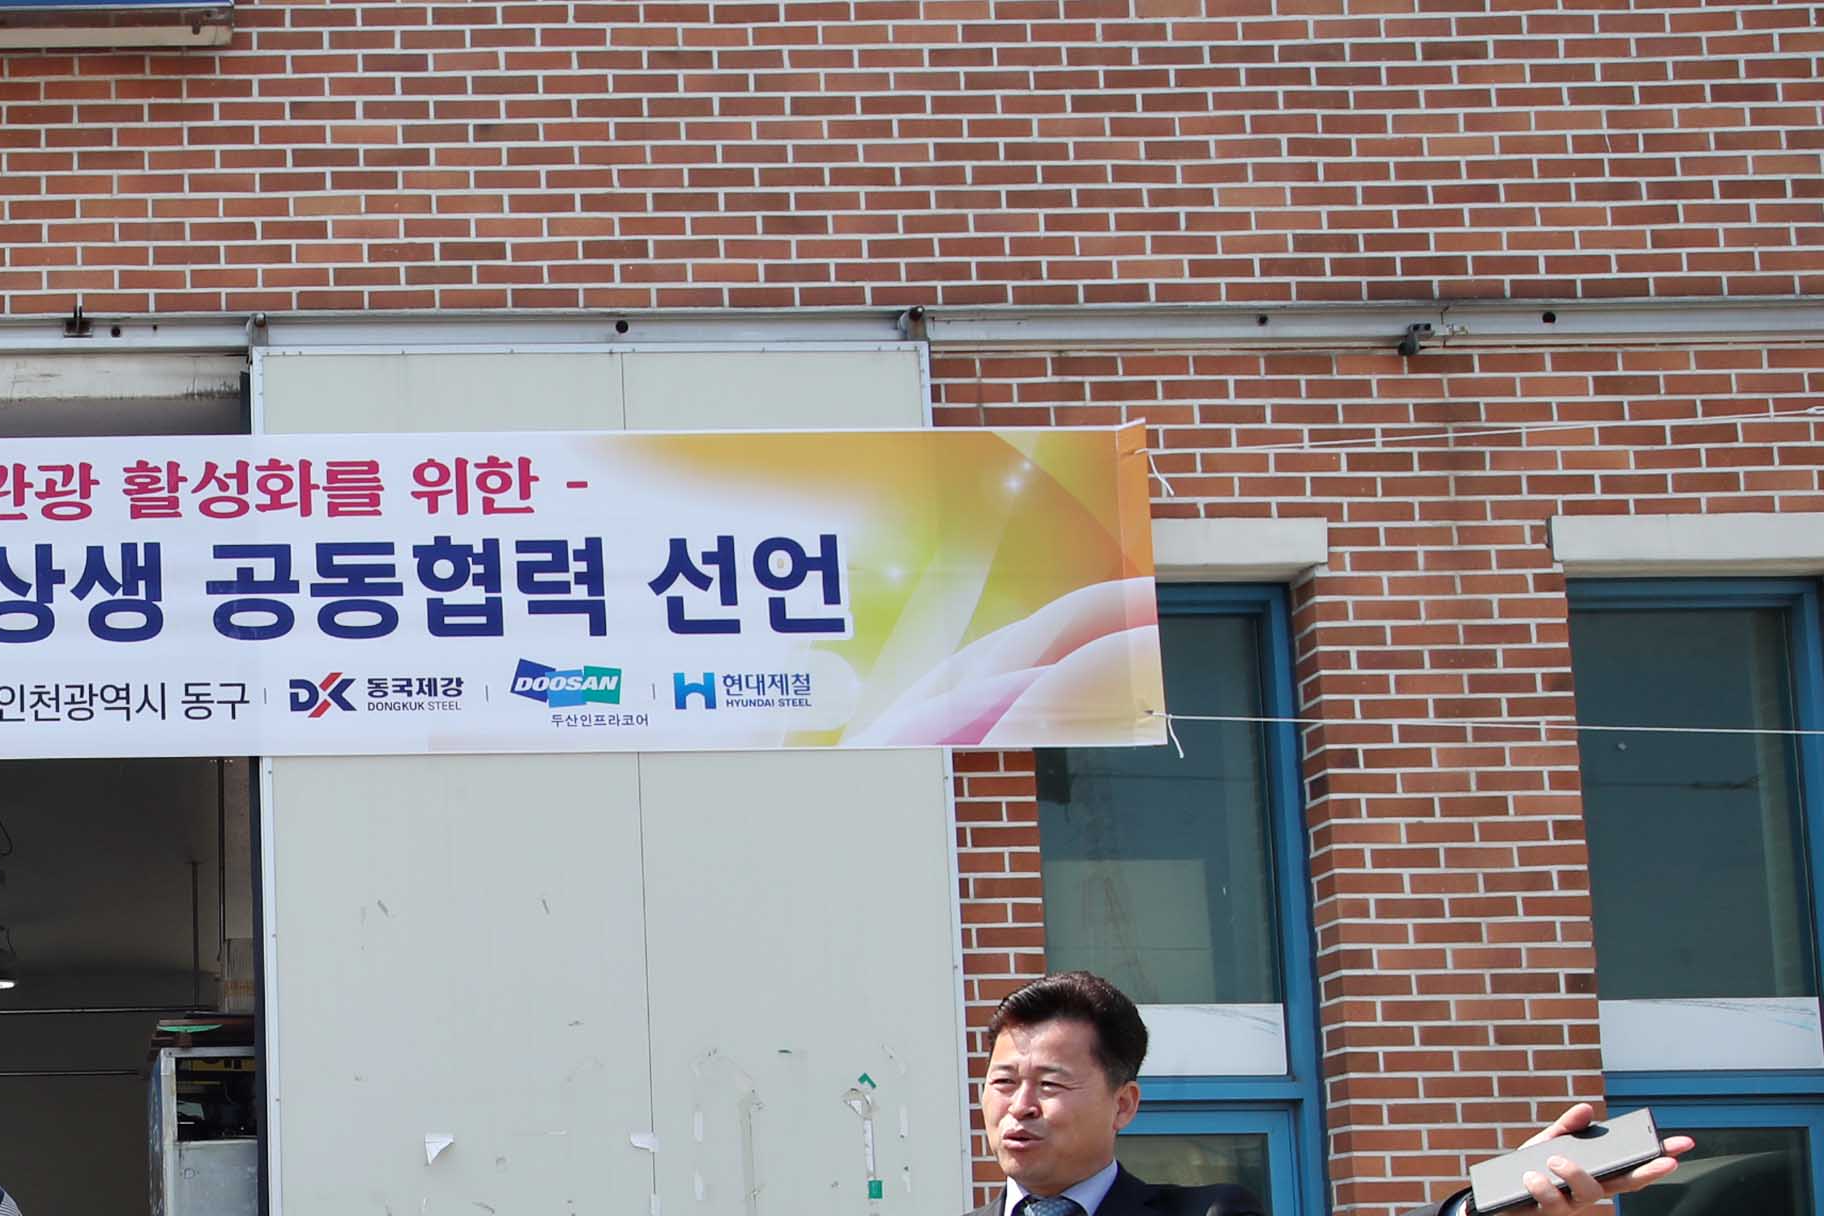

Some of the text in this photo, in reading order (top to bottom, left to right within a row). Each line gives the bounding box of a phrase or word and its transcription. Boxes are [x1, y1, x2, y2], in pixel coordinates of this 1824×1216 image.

[123, 458, 384, 519] 활성화를
[411, 456, 539, 515] 위한
[206, 536, 607, 640] 공동협력
[648, 534, 848, 634] 선언
[367, 677, 464, 698] 동국제강
[514, 674, 619, 693] DOOSAN
[722, 673, 811, 697] 현대제철
[180, 682, 250, 721] 동구
[367, 701, 462, 712] DONGKUK STEEL
[725, 698, 812, 708] HYUNDAI STEEL
[551, 713, 649, 728] 두산인프라코어
